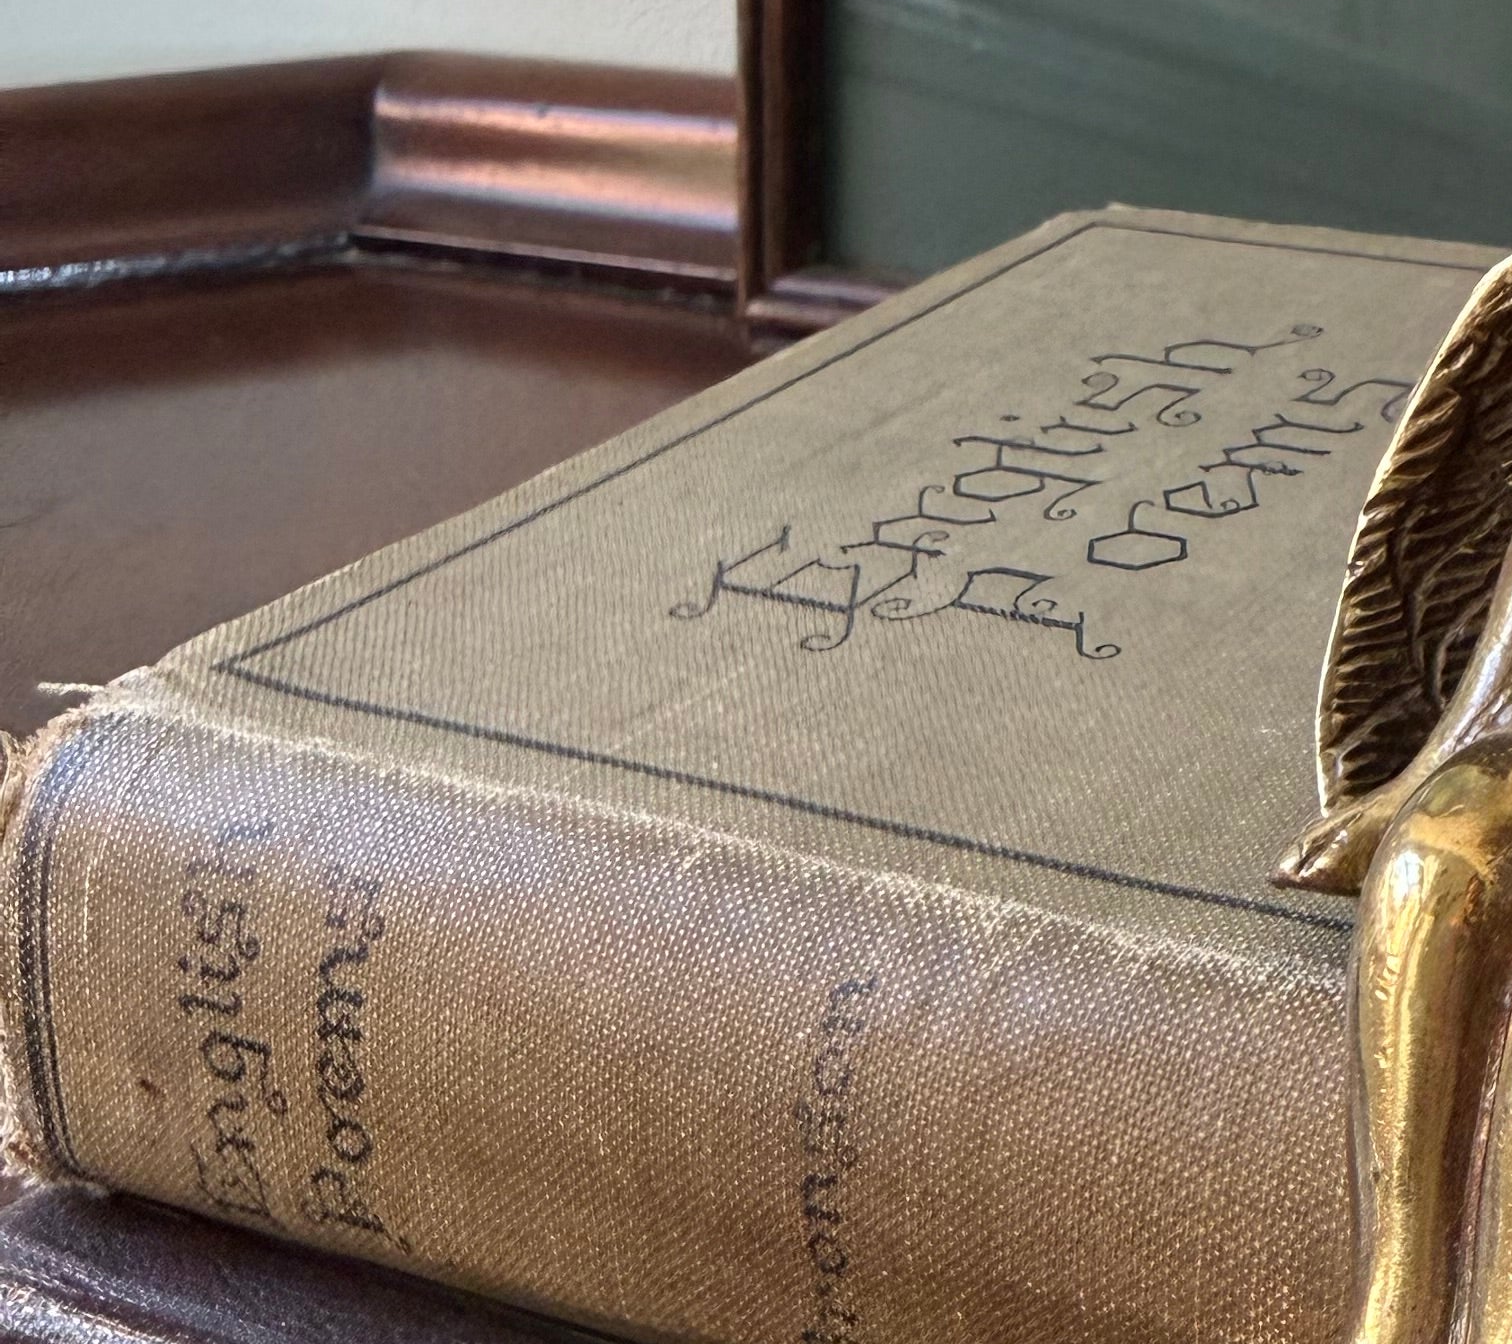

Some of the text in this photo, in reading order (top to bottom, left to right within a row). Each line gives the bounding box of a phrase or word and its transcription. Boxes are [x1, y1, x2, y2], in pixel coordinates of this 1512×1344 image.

[669, 323, 1323, 651] English
[873, 368, 1413, 658] Poems
[298, 862, 412, 1256] Poems
